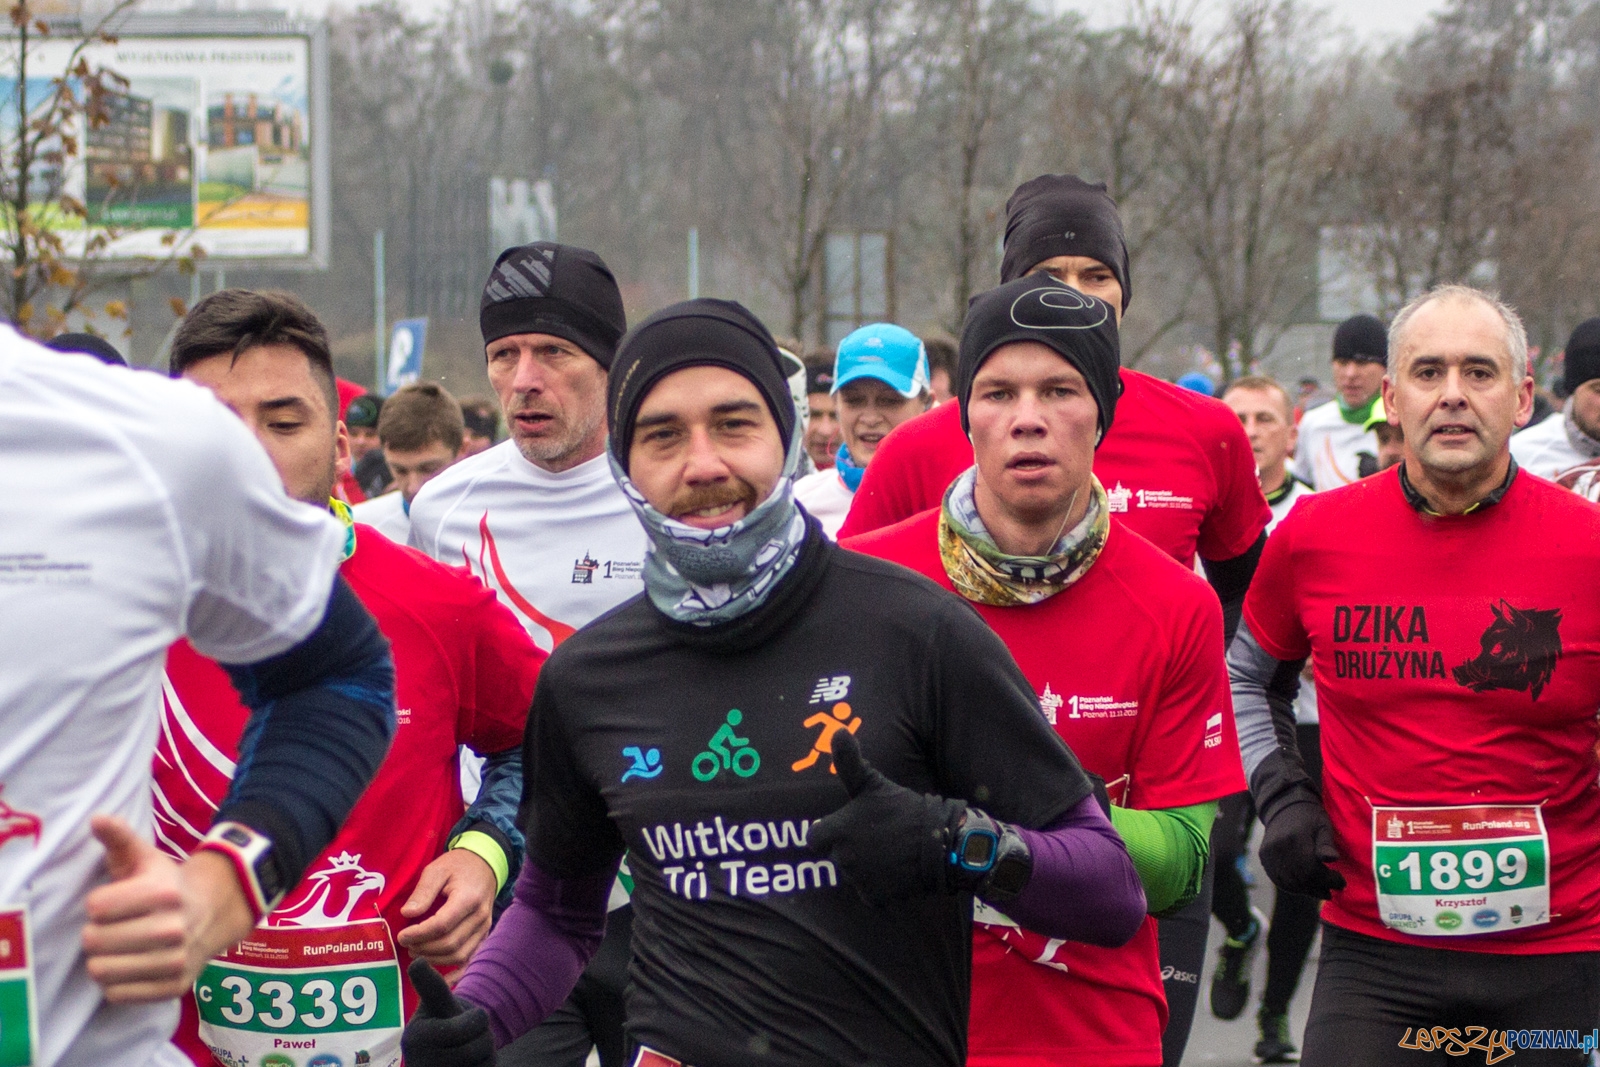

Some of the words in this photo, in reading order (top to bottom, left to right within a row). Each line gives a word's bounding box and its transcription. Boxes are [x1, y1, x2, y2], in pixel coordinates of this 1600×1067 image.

[1136, 489, 1147, 508] 1
[603, 560, 613, 578] 1
[1334, 605, 1429, 643] DZIKA
[1334, 645, 1446, 679] DRUŻYNA
[1068, 695, 1081, 718] 1
[1406, 821, 1415, 834] 1
[1463, 820, 1531, 830] RunPoland.org
[642, 816, 821, 861] Witkow
[1398, 847, 1529, 891] 1899
[663, 861, 707, 899] Tri
[720, 860, 837, 896] Team
[1435, 897, 1488, 910] Krzysztof
[303, 940, 384, 956] RunPoland.org
[1173, 970, 1198, 984] asics
[220, 975, 378, 1029] 3339
[273, 1038, 316, 1049] Paweł
